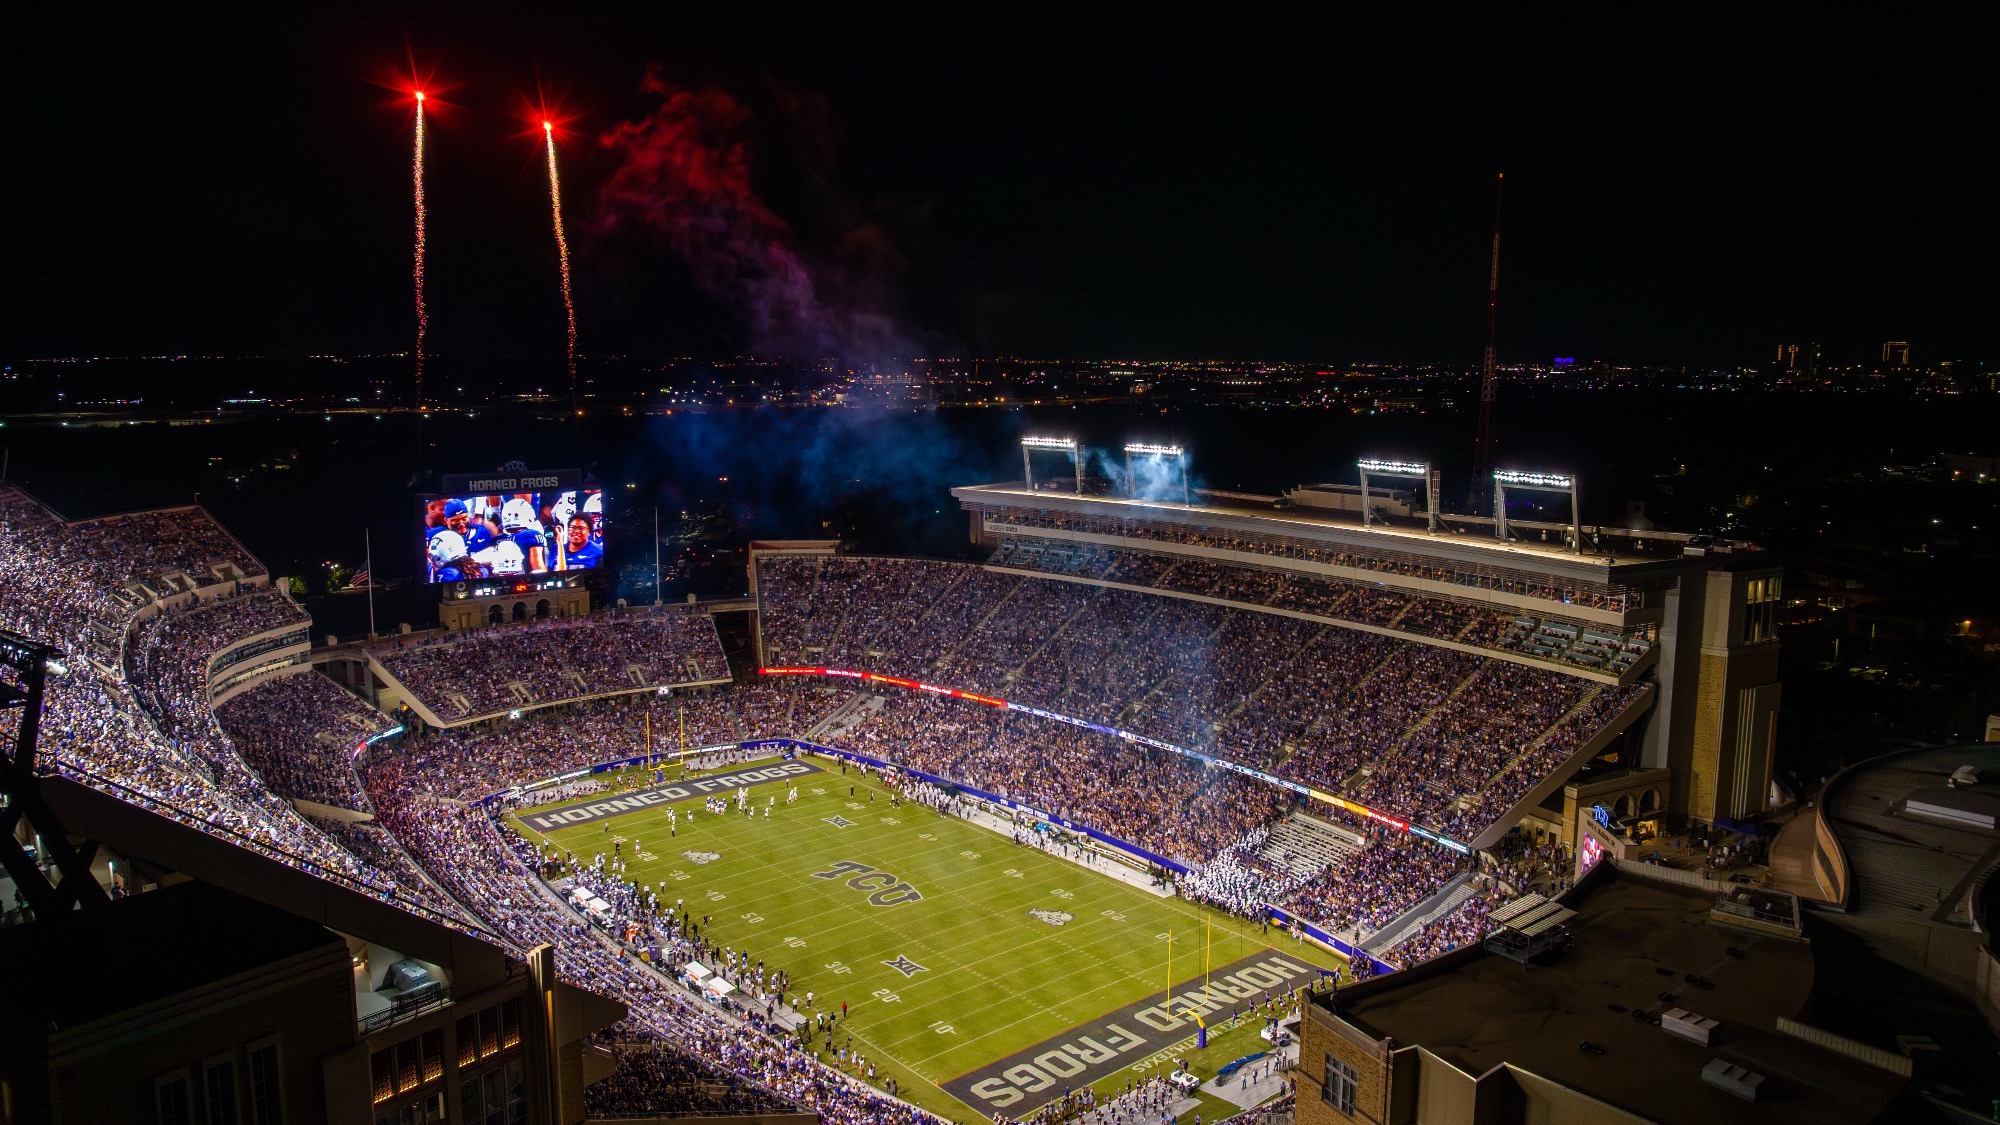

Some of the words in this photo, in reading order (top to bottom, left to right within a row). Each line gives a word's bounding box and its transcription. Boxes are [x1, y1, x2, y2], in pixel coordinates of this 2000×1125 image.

[469, 478, 517, 491] HORNED
[520, 476, 559, 489] FROGS
[533, 786, 691, 828] HORNED
[692, 763, 811, 792] FROGS
[810, 861, 924, 906] TCU
[741, 912, 764, 924] 50
[1101, 909, 1123, 921] 20
[783, 936, 805, 948] 40
[825, 961, 849, 974] 30
[871, 988, 901, 1003] 20
[1134, 956, 1309, 1032] HORNED
[928, 1020, 955, 1035] 10
[970, 1023, 1147, 1107] FROGS
[1131, 1050, 1178, 1073] TEXAS
